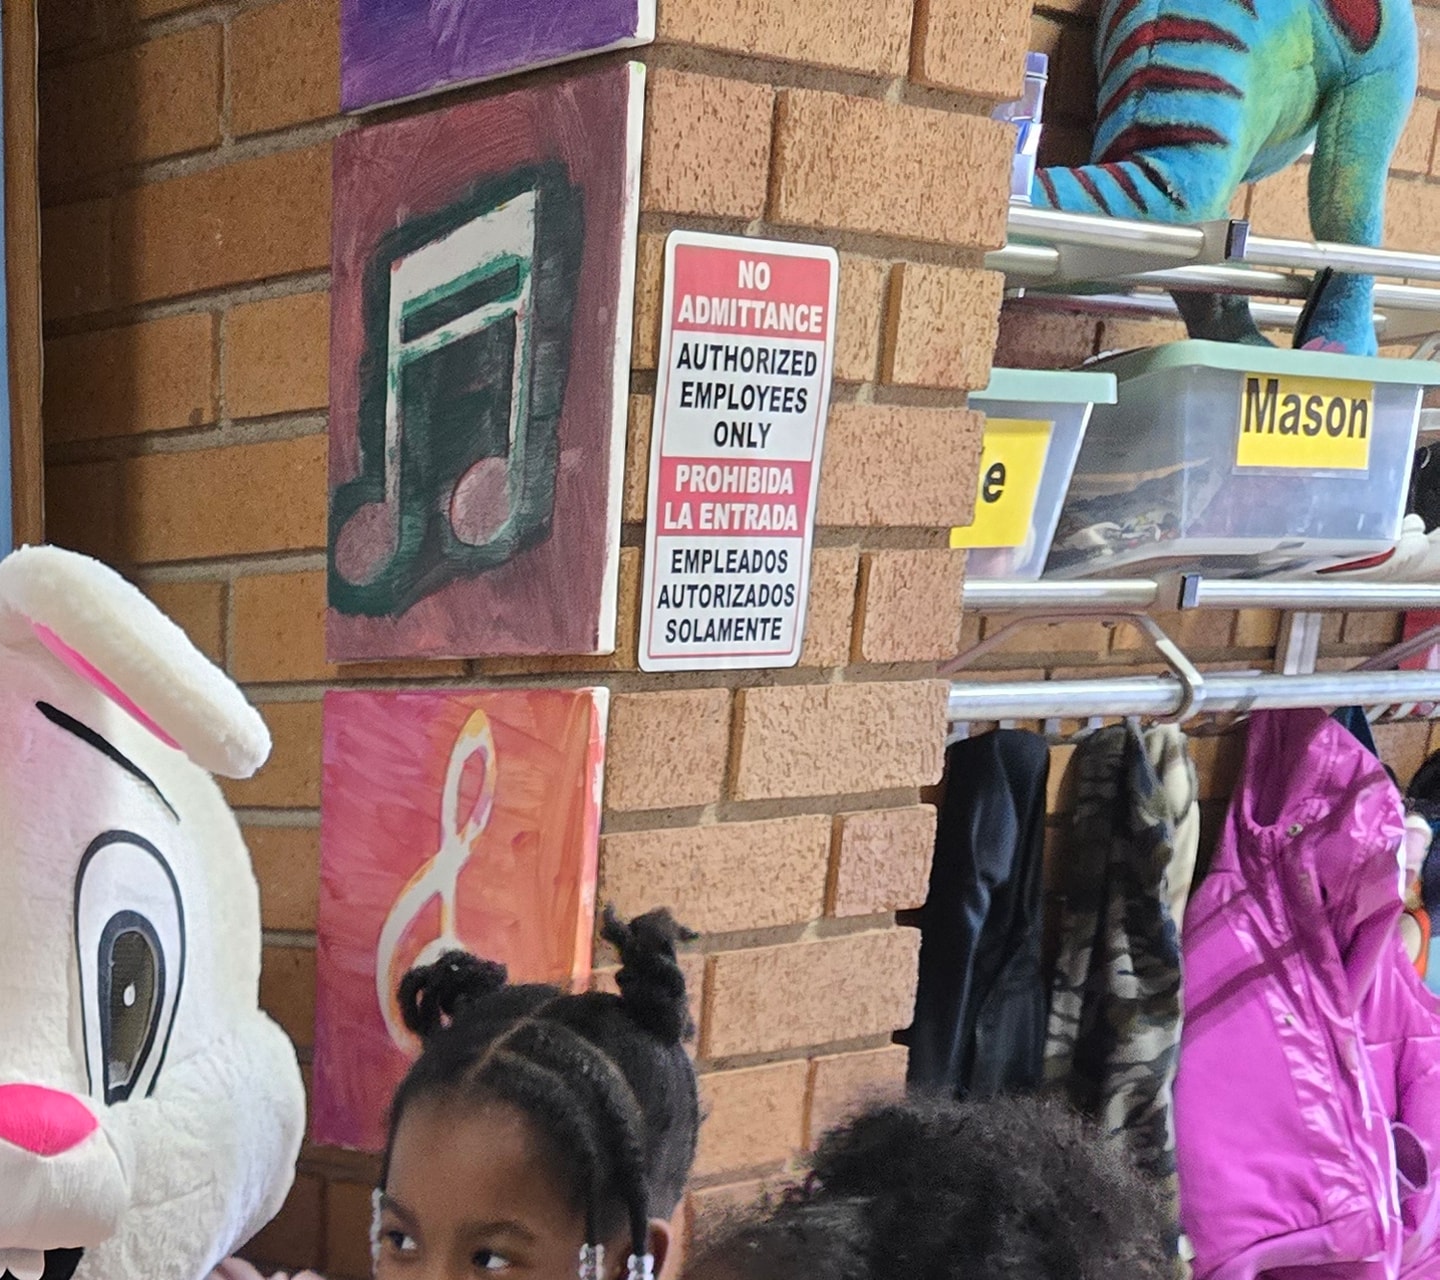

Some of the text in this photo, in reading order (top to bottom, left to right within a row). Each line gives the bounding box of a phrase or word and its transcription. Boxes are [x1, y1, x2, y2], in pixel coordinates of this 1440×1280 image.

[737, 259, 772, 291] NO
[677, 294, 824, 334] ADMITTANCE
[676, 342, 818, 378] AUTHORIZED
[679, 380, 809, 414] EMPLOYEES
[1243, 377, 1368, 440] Mason
[713, 420, 773, 449] ONLY
[674, 464, 795, 495] PROHIBIDA
[663, 501, 799, 532] LA ENTRADA
[670, 548, 789, 575] EMPLEADOS
[656, 582, 796, 610] AUTORIZADOS
[664, 616, 783, 644] SOLAMENTE
